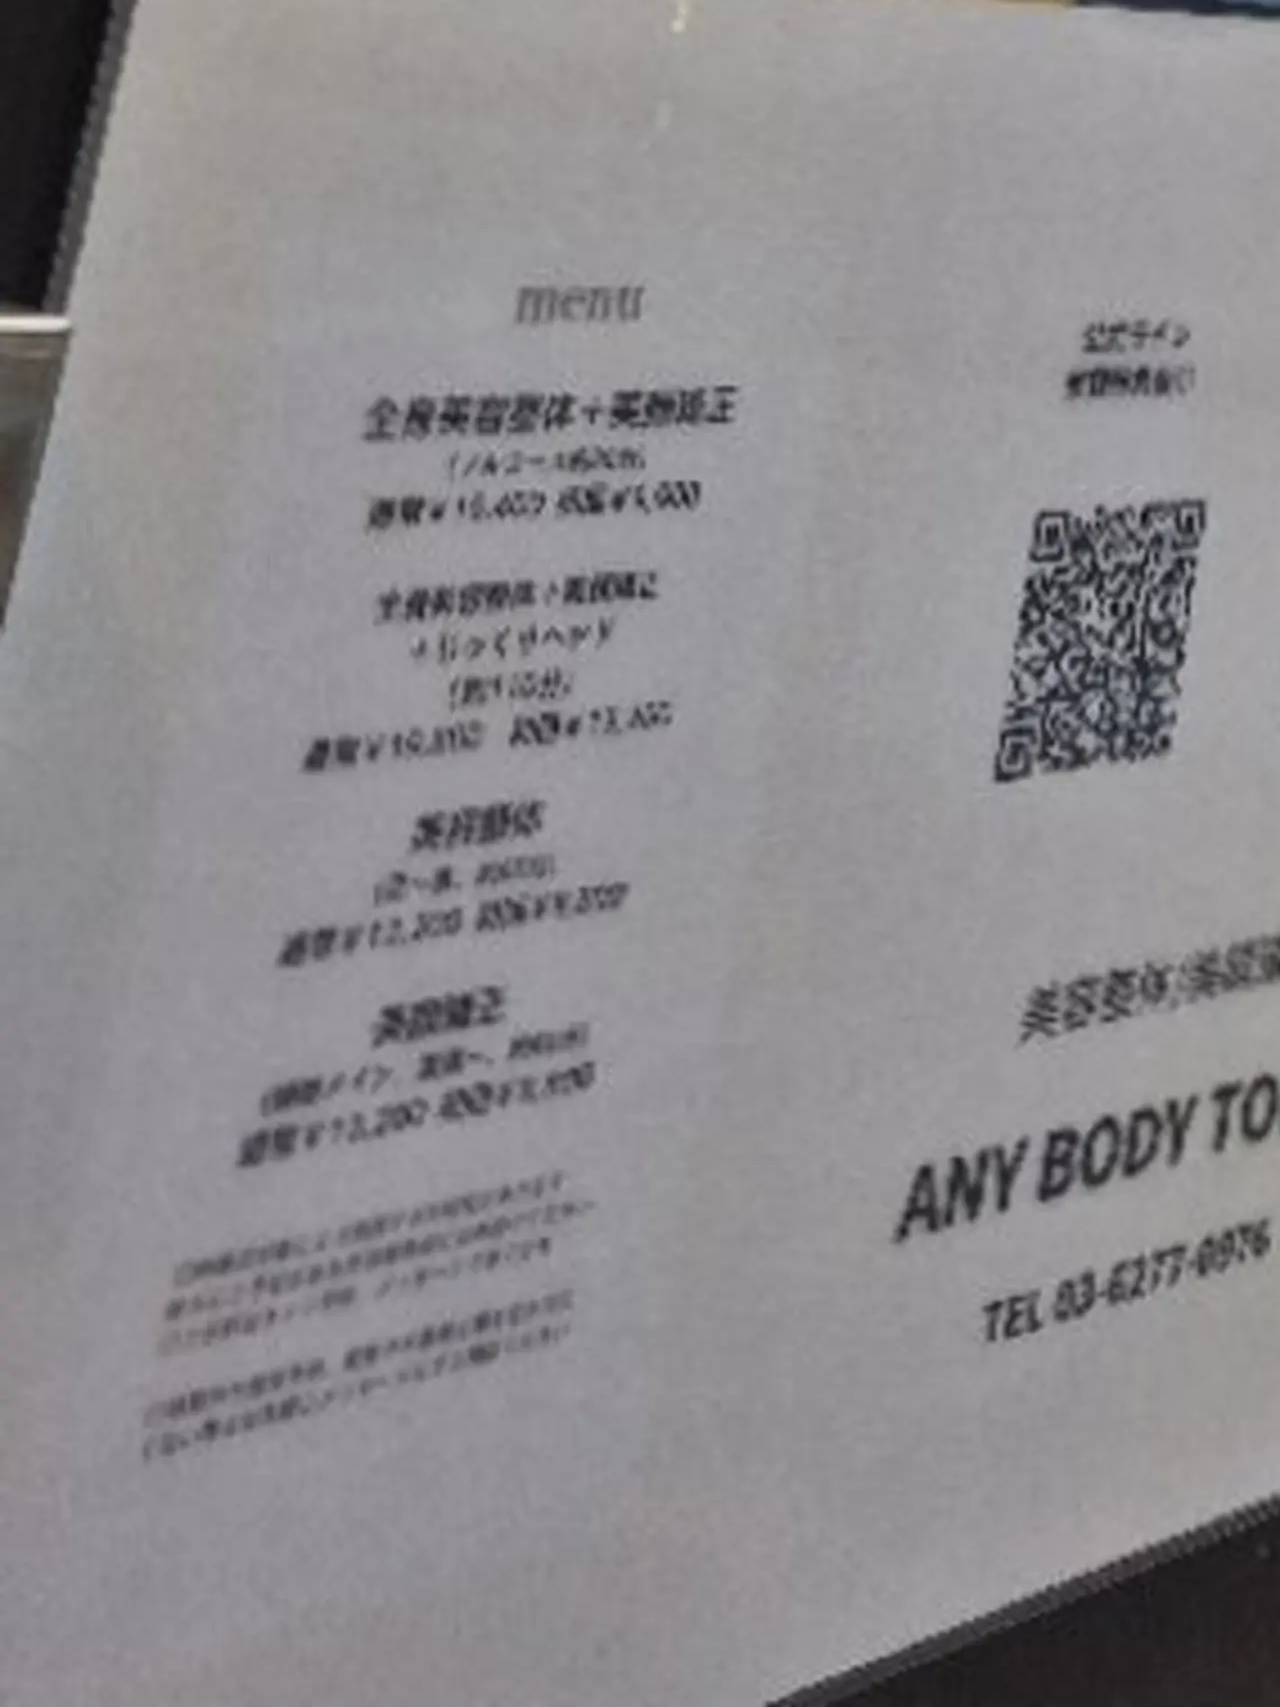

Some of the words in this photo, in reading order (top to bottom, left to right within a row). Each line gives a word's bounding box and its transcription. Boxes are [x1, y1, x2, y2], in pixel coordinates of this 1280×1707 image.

[513, 284, 645, 325] menu
[893, 1137, 1029, 1244] ANY
[1036, 1094, 1199, 1203] BODY
[982, 1289, 1043, 1342] TEL
